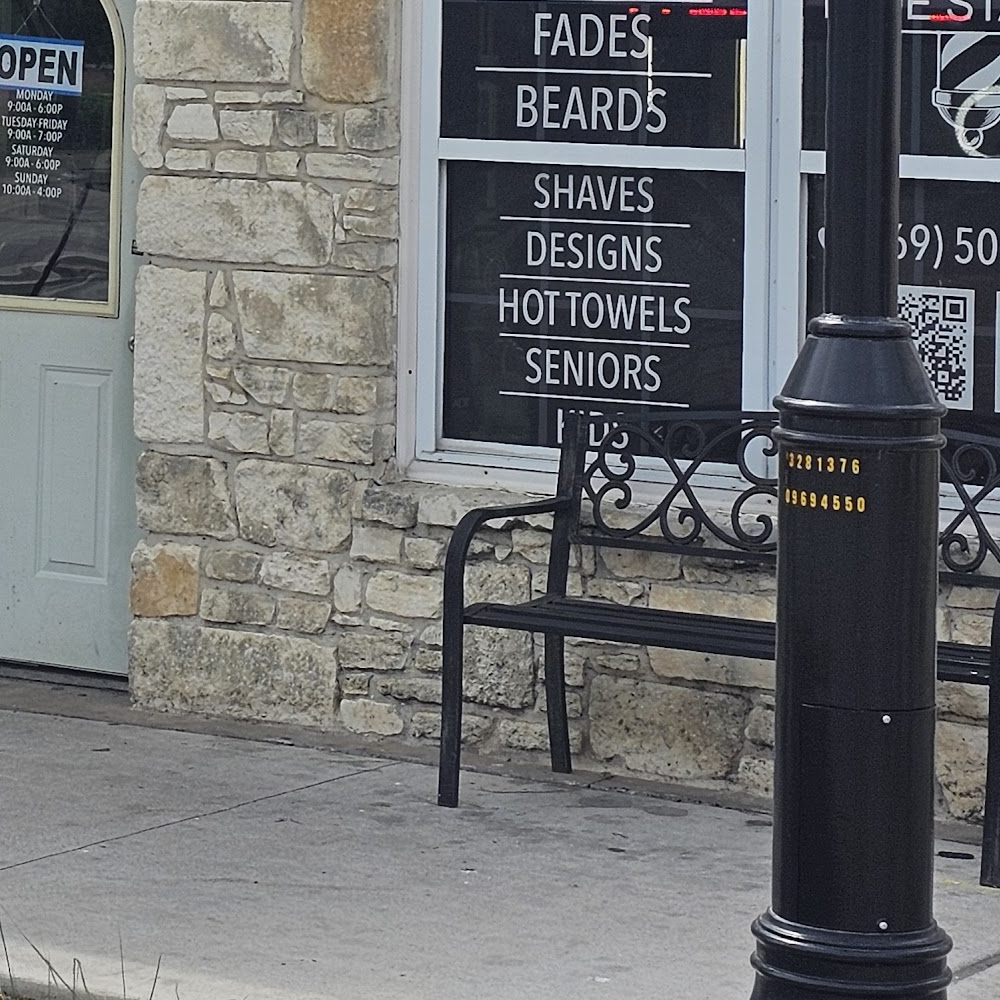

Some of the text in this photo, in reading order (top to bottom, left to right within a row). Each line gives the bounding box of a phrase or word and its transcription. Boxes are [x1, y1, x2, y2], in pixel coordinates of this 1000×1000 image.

[533, 13, 651, 59] FADES
[16, 89, 53, 101] MONDAY
[7, 101, 32, 113] 9:00A
[37, 103, 63, 115] 6:00P
[516, 84, 667, 134] BEARDS
[7, 128, 32, 140] 9:00A
[38, 130, 63, 143] 7:00P
[11, 143, 53, 157] SATURDAY
[5, 156, 30, 168] 9:00A
[35, 159, 61, 171] 6:00P
[14, 171, 48, 185] SUNDAY
[2, 184, 31, 196] 10:00A
[37, 186, 63, 198] 4:00P
[533, 172, 655, 213] SHAVES
[526, 230, 663, 273] DESIGNS
[499, 287, 691, 334] HOT TOWELS
[525, 347, 661, 392] SENIORS
